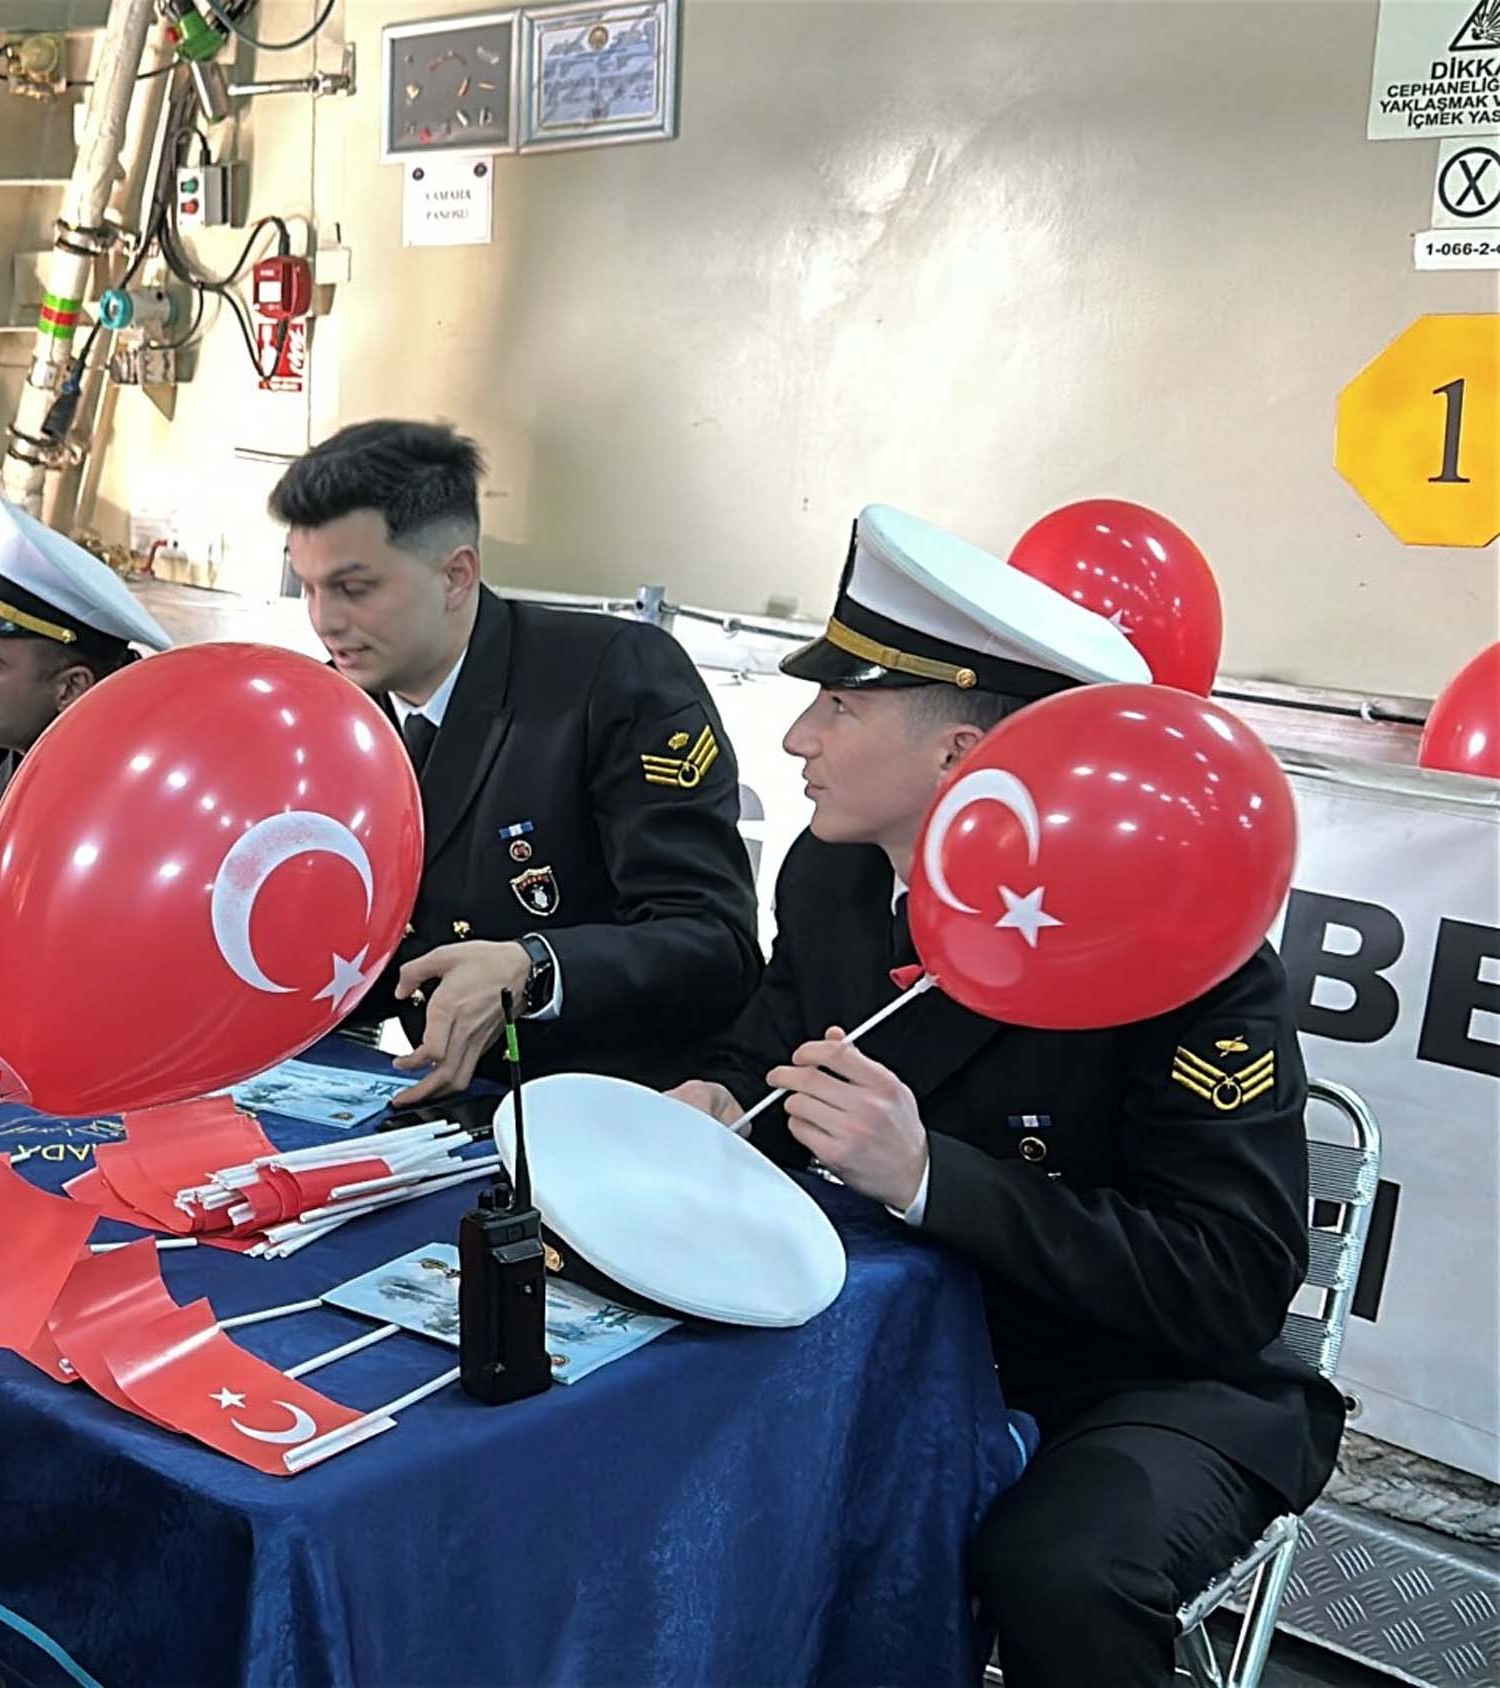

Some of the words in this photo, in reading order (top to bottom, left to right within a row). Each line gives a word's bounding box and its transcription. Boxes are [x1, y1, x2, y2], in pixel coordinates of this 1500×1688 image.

[1380, 94, 1488, 113] YAKLAŞMAK
[1408, 111, 1463, 129] İÇMEK
[1427, 378, 1471, 483] 1
